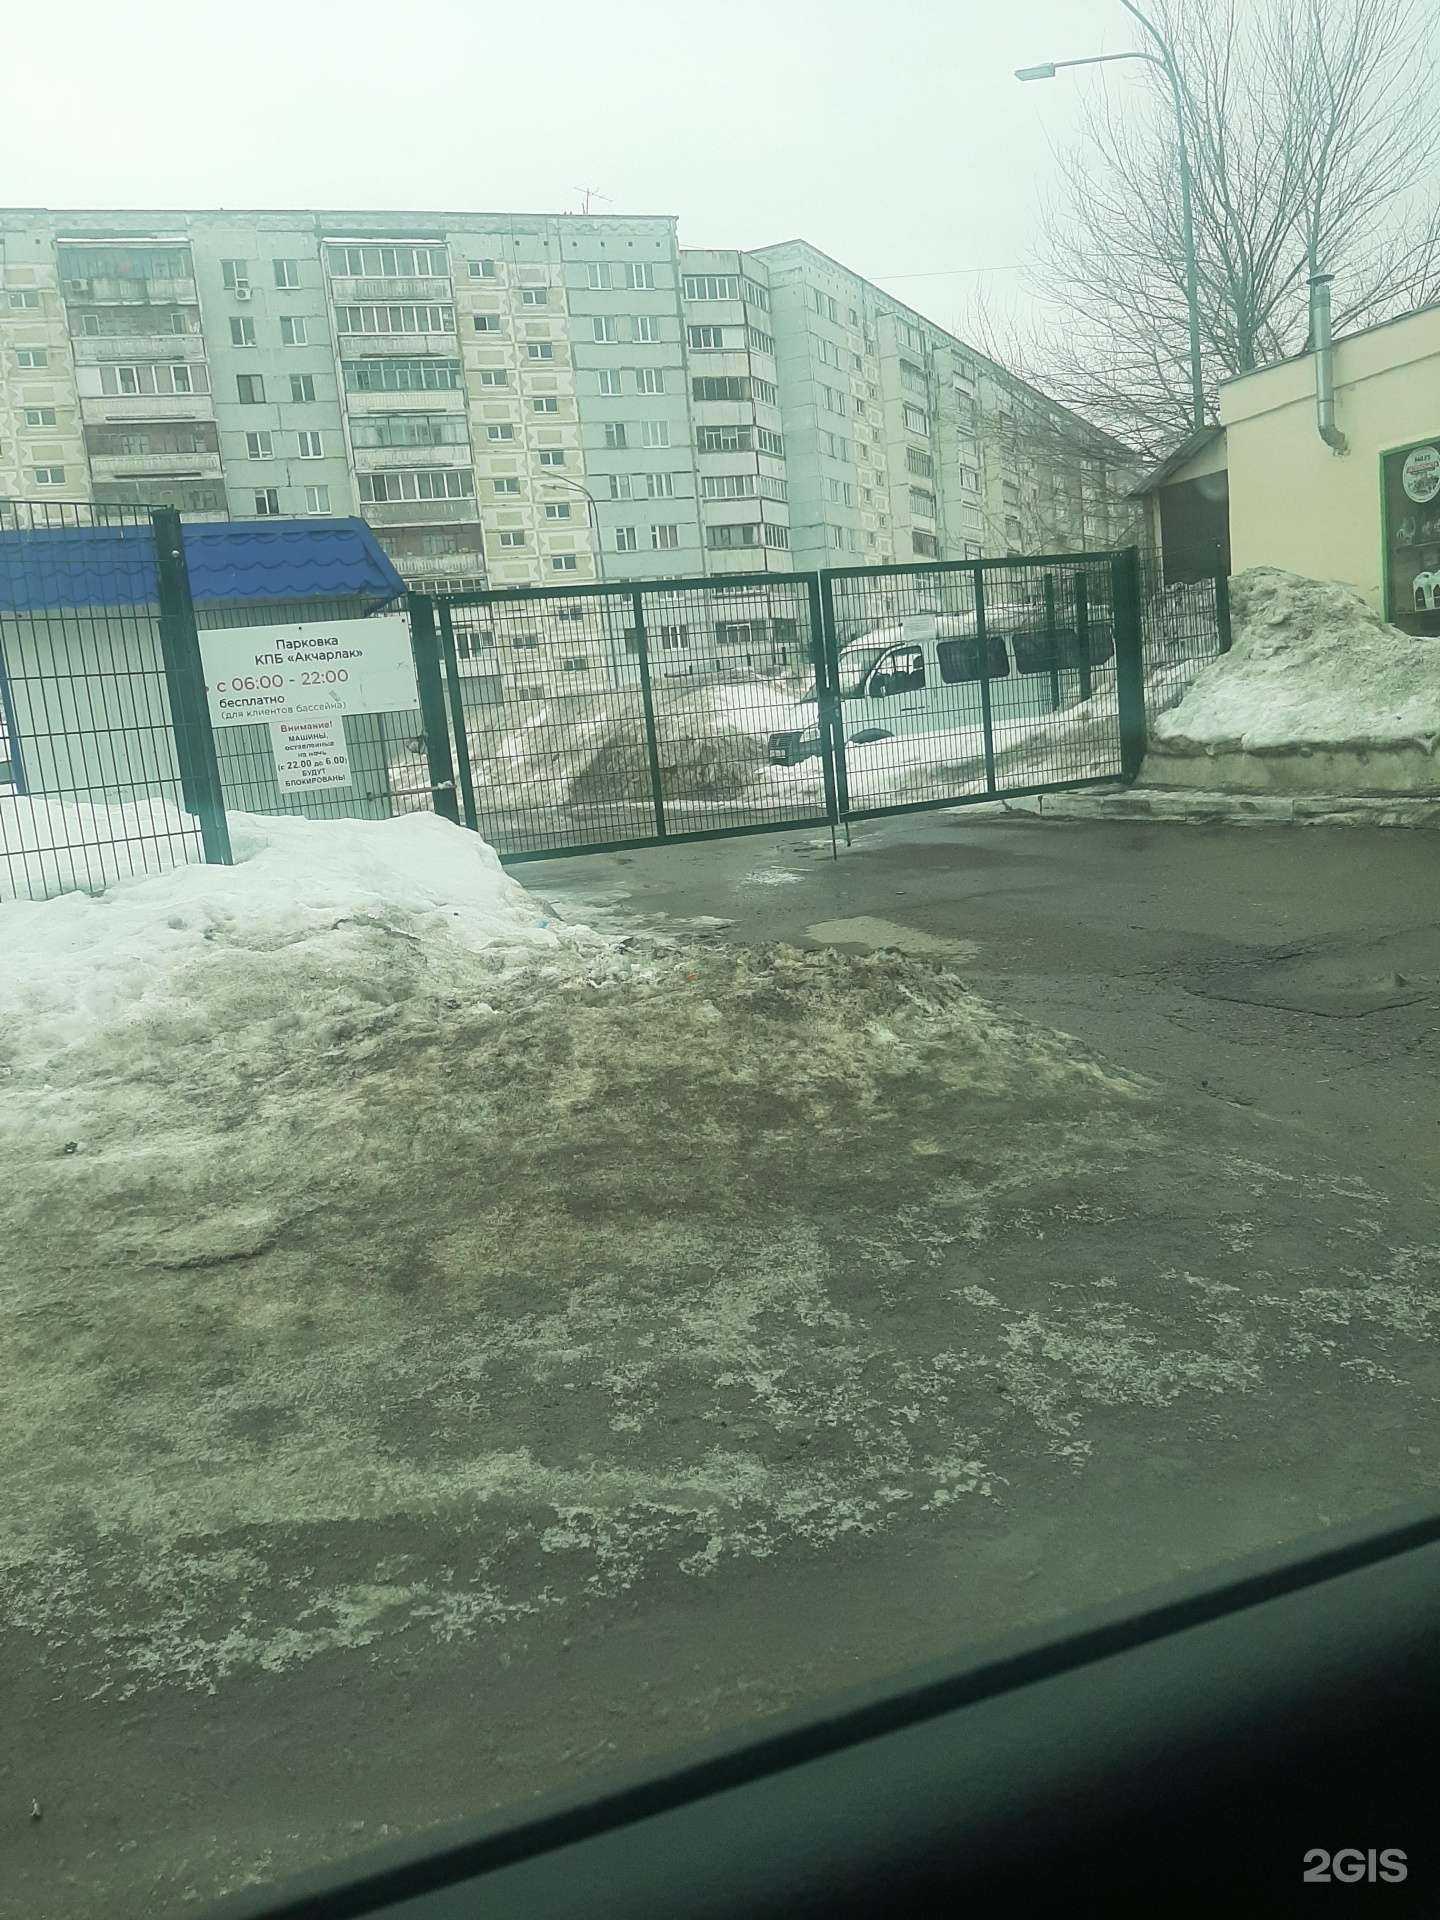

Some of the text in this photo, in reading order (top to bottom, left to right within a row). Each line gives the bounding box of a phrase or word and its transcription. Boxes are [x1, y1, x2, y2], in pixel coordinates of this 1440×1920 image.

[276, 636, 339, 651] Парковка
[255, 649, 363, 666] КПБ «Акчарлак»
[216, 681, 227, 693] с
[231, 674, 284, 691] 06:00
[301, 669, 349, 686] 22:00
[219, 695, 285, 709] бесплатно
[221, 701, 347, 720] (для клиентов бассейна)
[280, 720, 333, 732] Внимание!
[287, 759, 312, 770] 22.00
[302, 768, 326, 777] БУДУТ
[285, 774, 346, 787] БЛОКИРОВАНЫ
